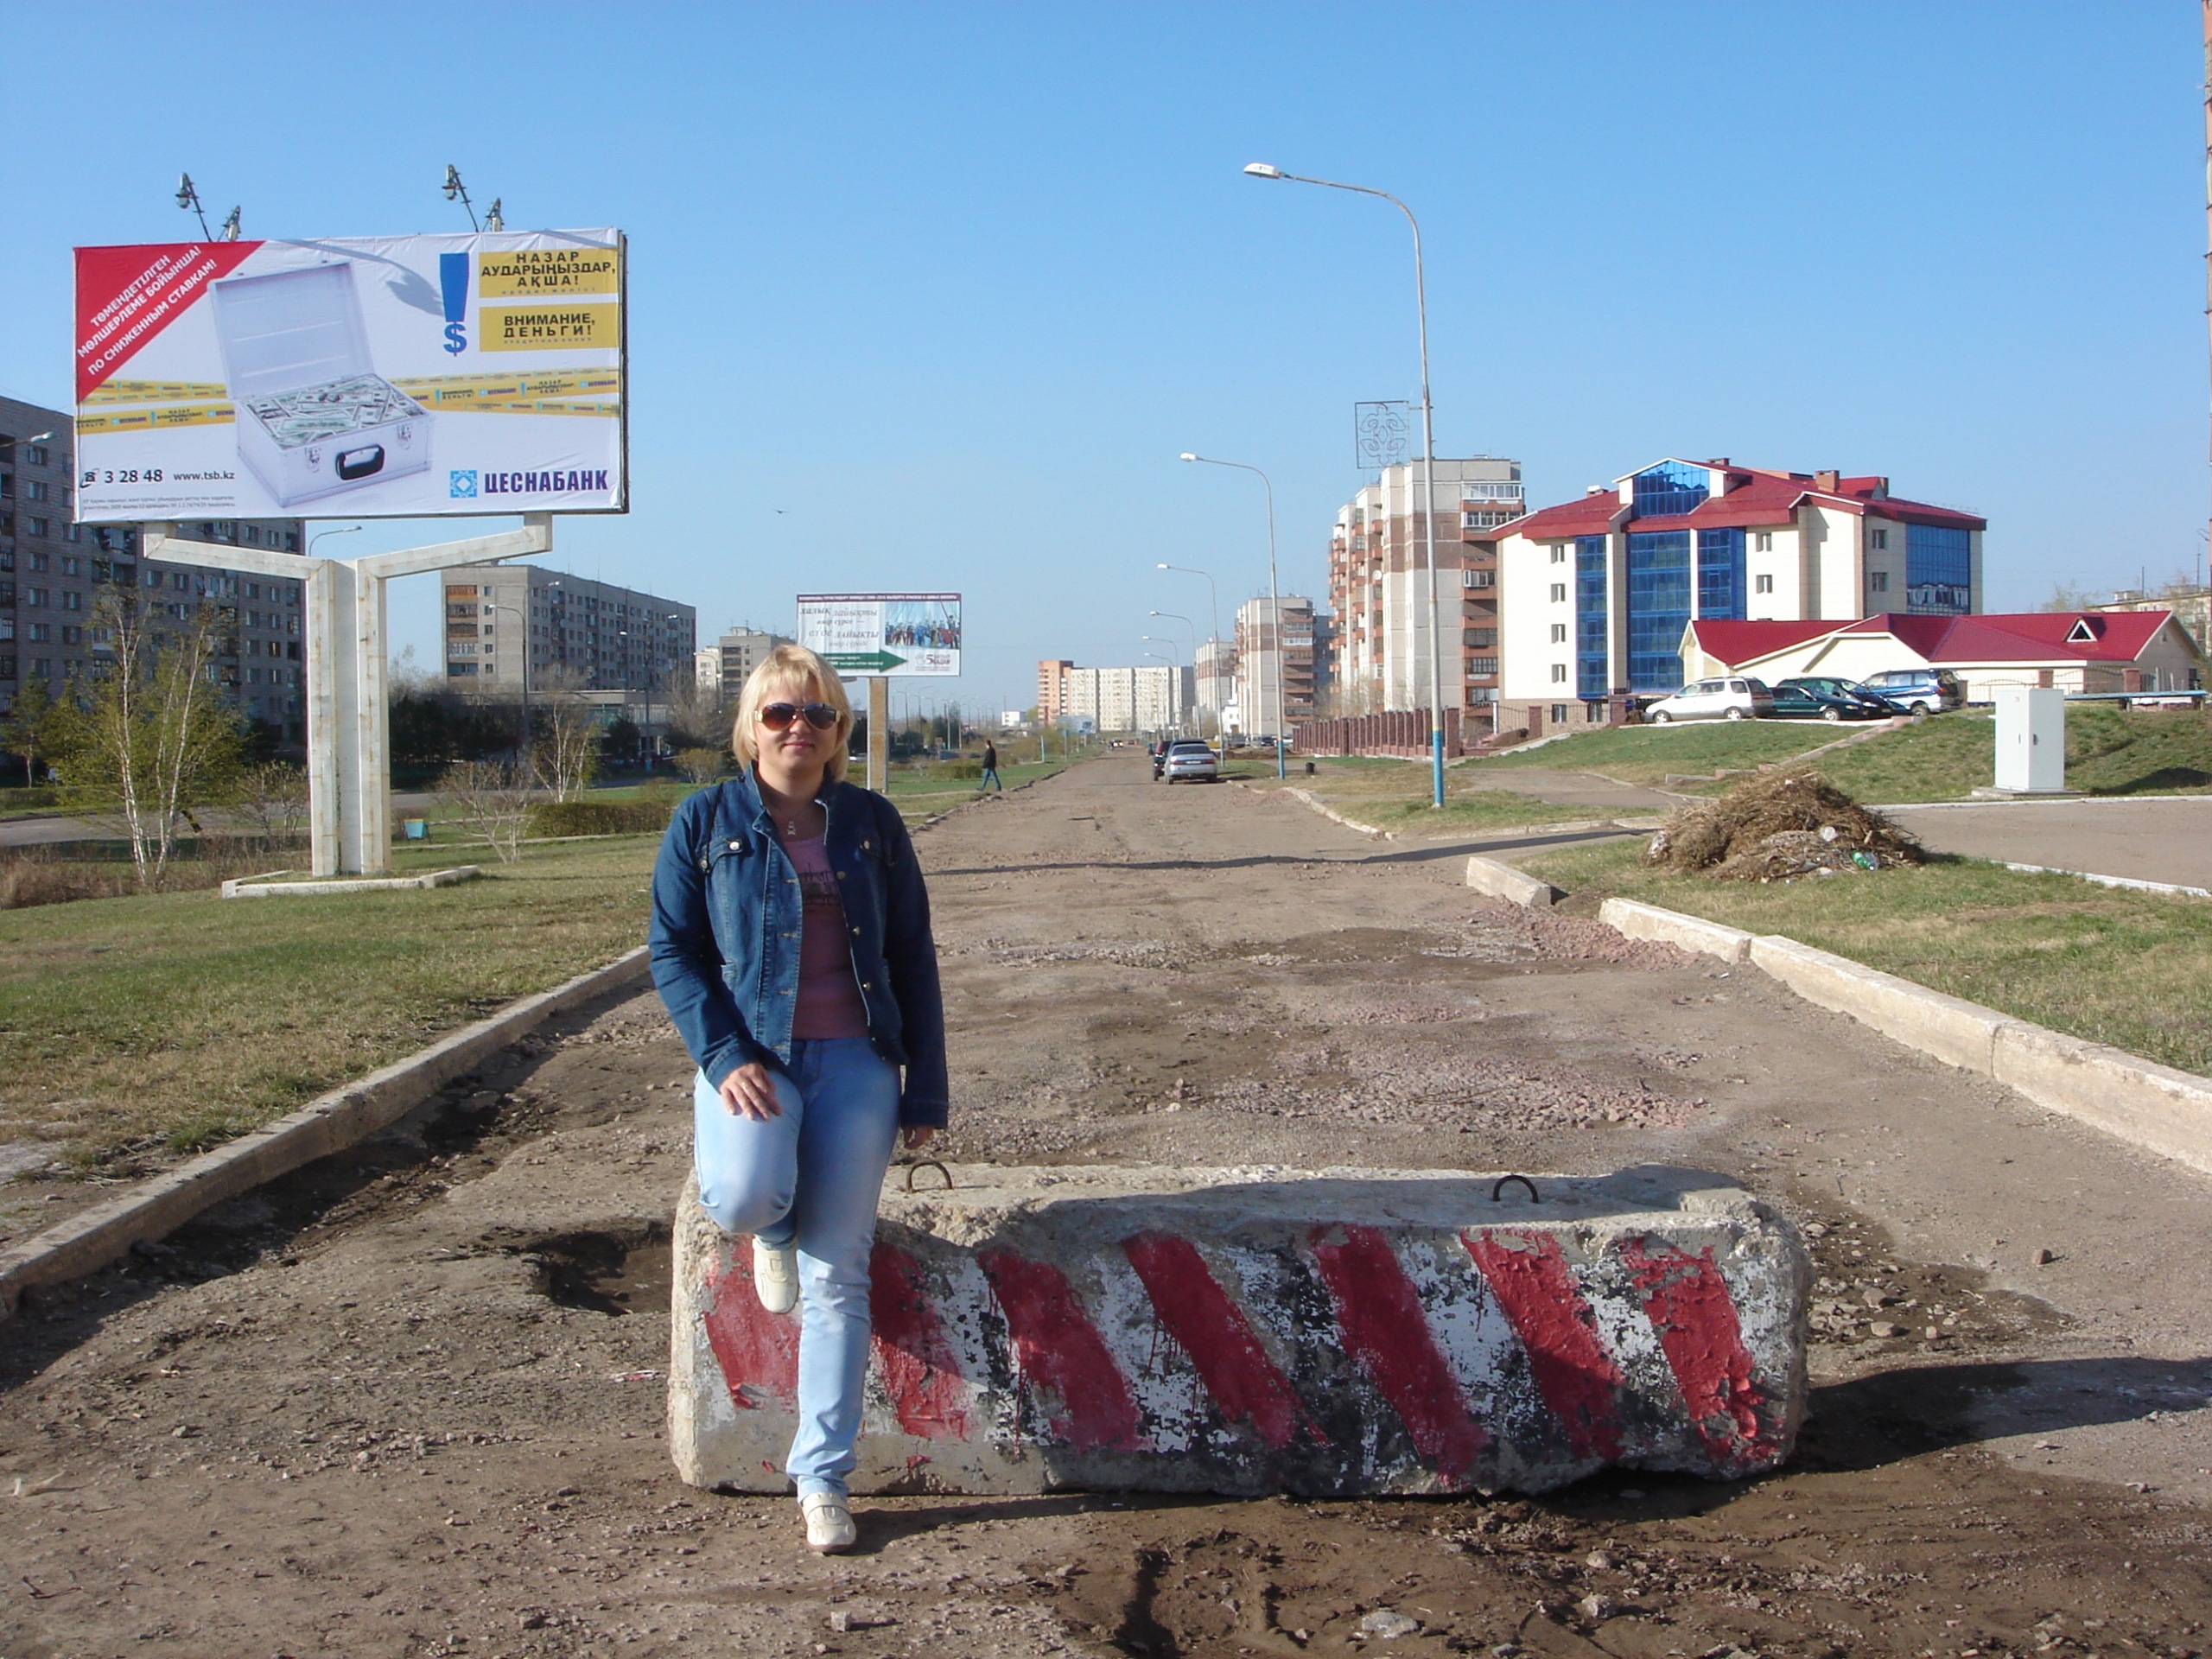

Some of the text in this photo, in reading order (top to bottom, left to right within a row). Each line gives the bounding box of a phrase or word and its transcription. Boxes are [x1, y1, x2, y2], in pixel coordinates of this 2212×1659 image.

[516, 251, 580, 264] НАЗАР
[480, 262, 616, 277] АУДАРЫҢЫЗДАР,
[517, 275, 579, 289] АҚША!
[90, 255, 171, 327] ТӨМЕНДЕТІЛГЕН
[77, 245, 201, 358] МӨЛШЕРЛЕМЕ БОЙЫНША!
[87, 258, 218, 376] ПО СНИЖЕННЫМ СТАВКАМ!
[504, 313, 595, 327] ВНИМАНИЕ,
[503, 325, 592, 339] ДЕНЬГИ!
[105, 469, 163, 484] 3 28 48
[173, 470, 235, 481] www.tsb.kz
[484, 469, 608, 493] ЦЕСНАБАНК
[926, 654, 934, 665] 5
